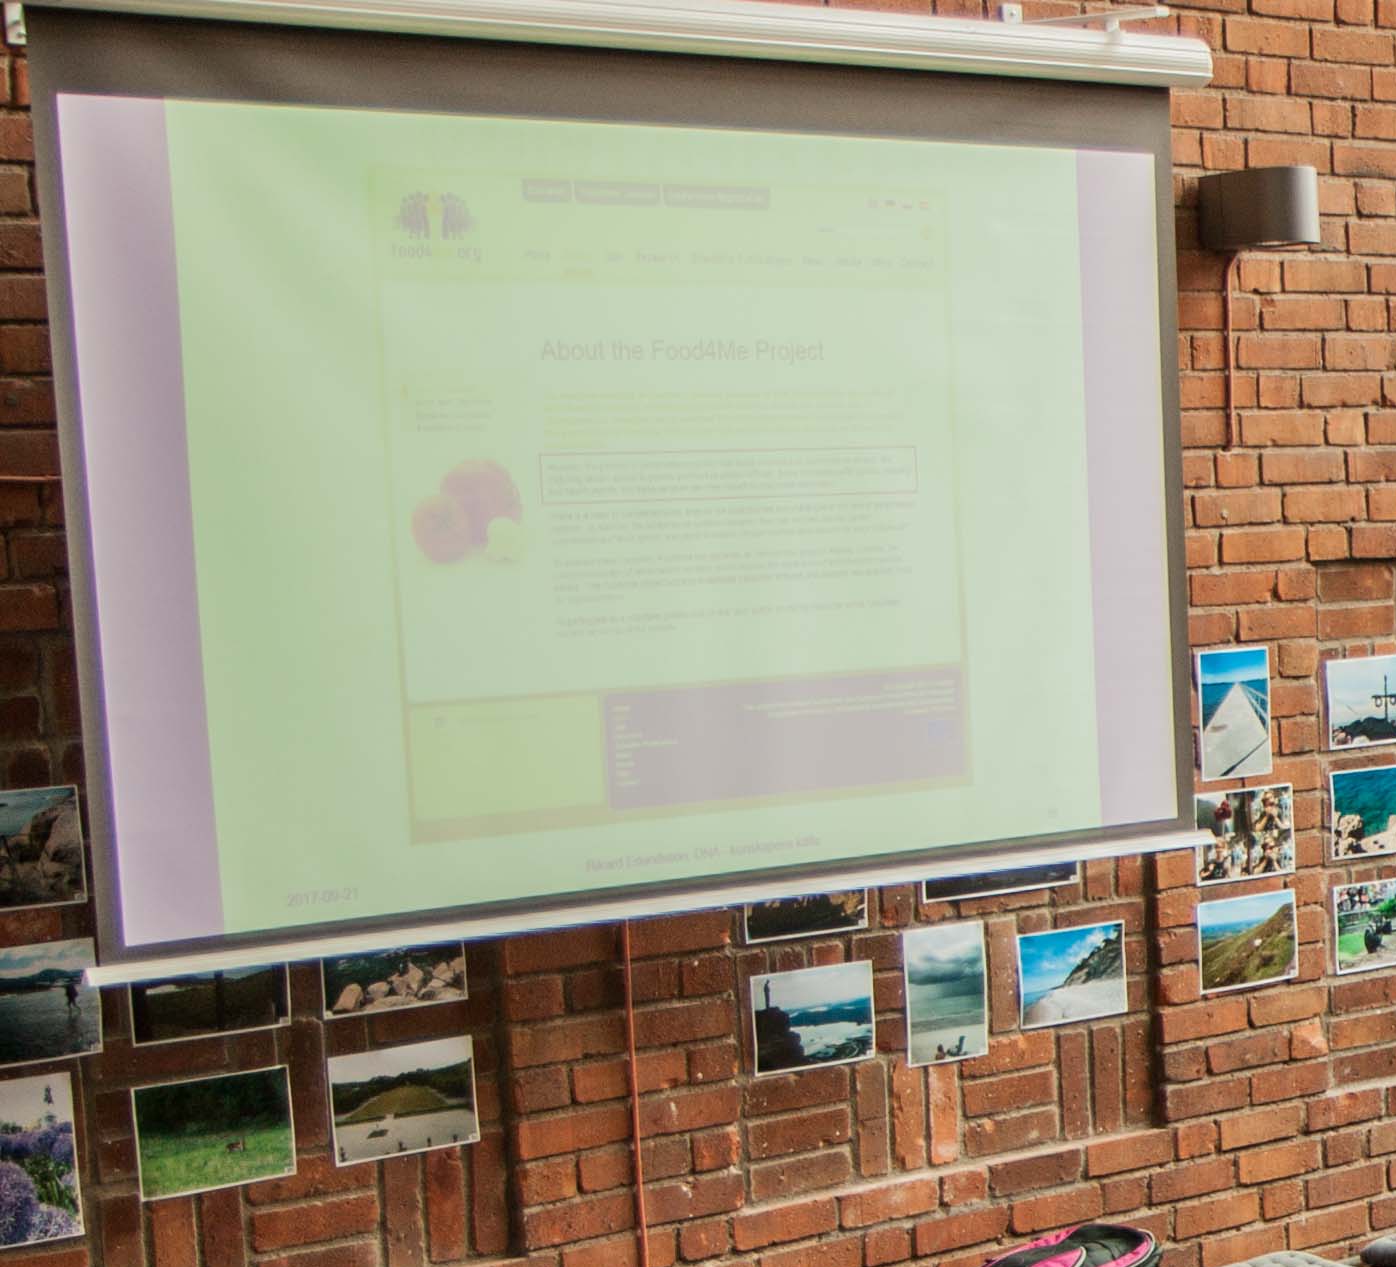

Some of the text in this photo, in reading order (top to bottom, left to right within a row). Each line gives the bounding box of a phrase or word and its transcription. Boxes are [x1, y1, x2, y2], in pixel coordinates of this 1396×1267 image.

[541, 338, 824, 366] About the Food4Me Project
